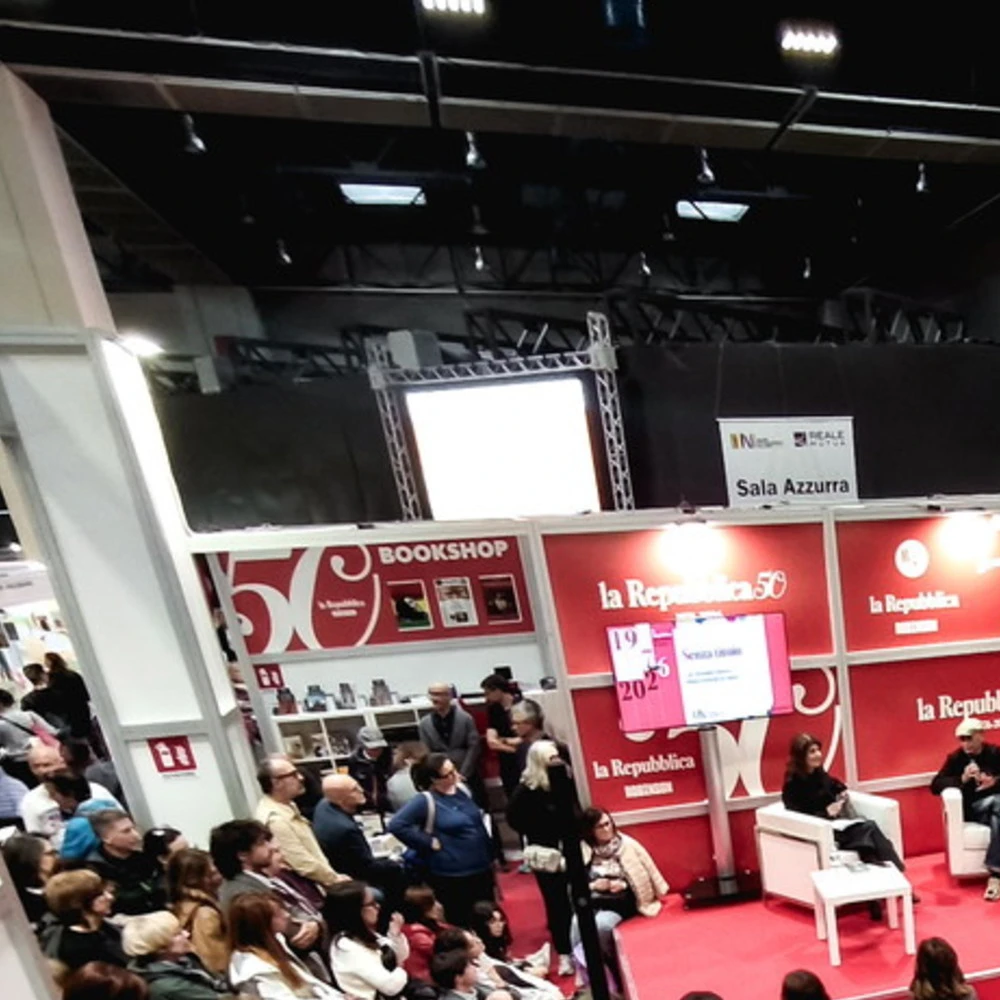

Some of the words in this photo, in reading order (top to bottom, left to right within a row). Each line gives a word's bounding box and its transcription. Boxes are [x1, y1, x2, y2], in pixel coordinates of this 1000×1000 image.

[736, 479, 778, 497] Sala
[783, 478, 849, 495] Azzurra
[379, 540, 509, 565] BOOKSHOP
[598, 581, 624, 610] la
[625, 576, 754, 612] Repuca
[869, 595, 883, 614] la
[885, 591, 960, 614] Repubblica
[917, 697, 936, 722] la
[592, 761, 609, 779] la
[610, 753, 696, 779] Repubblica
